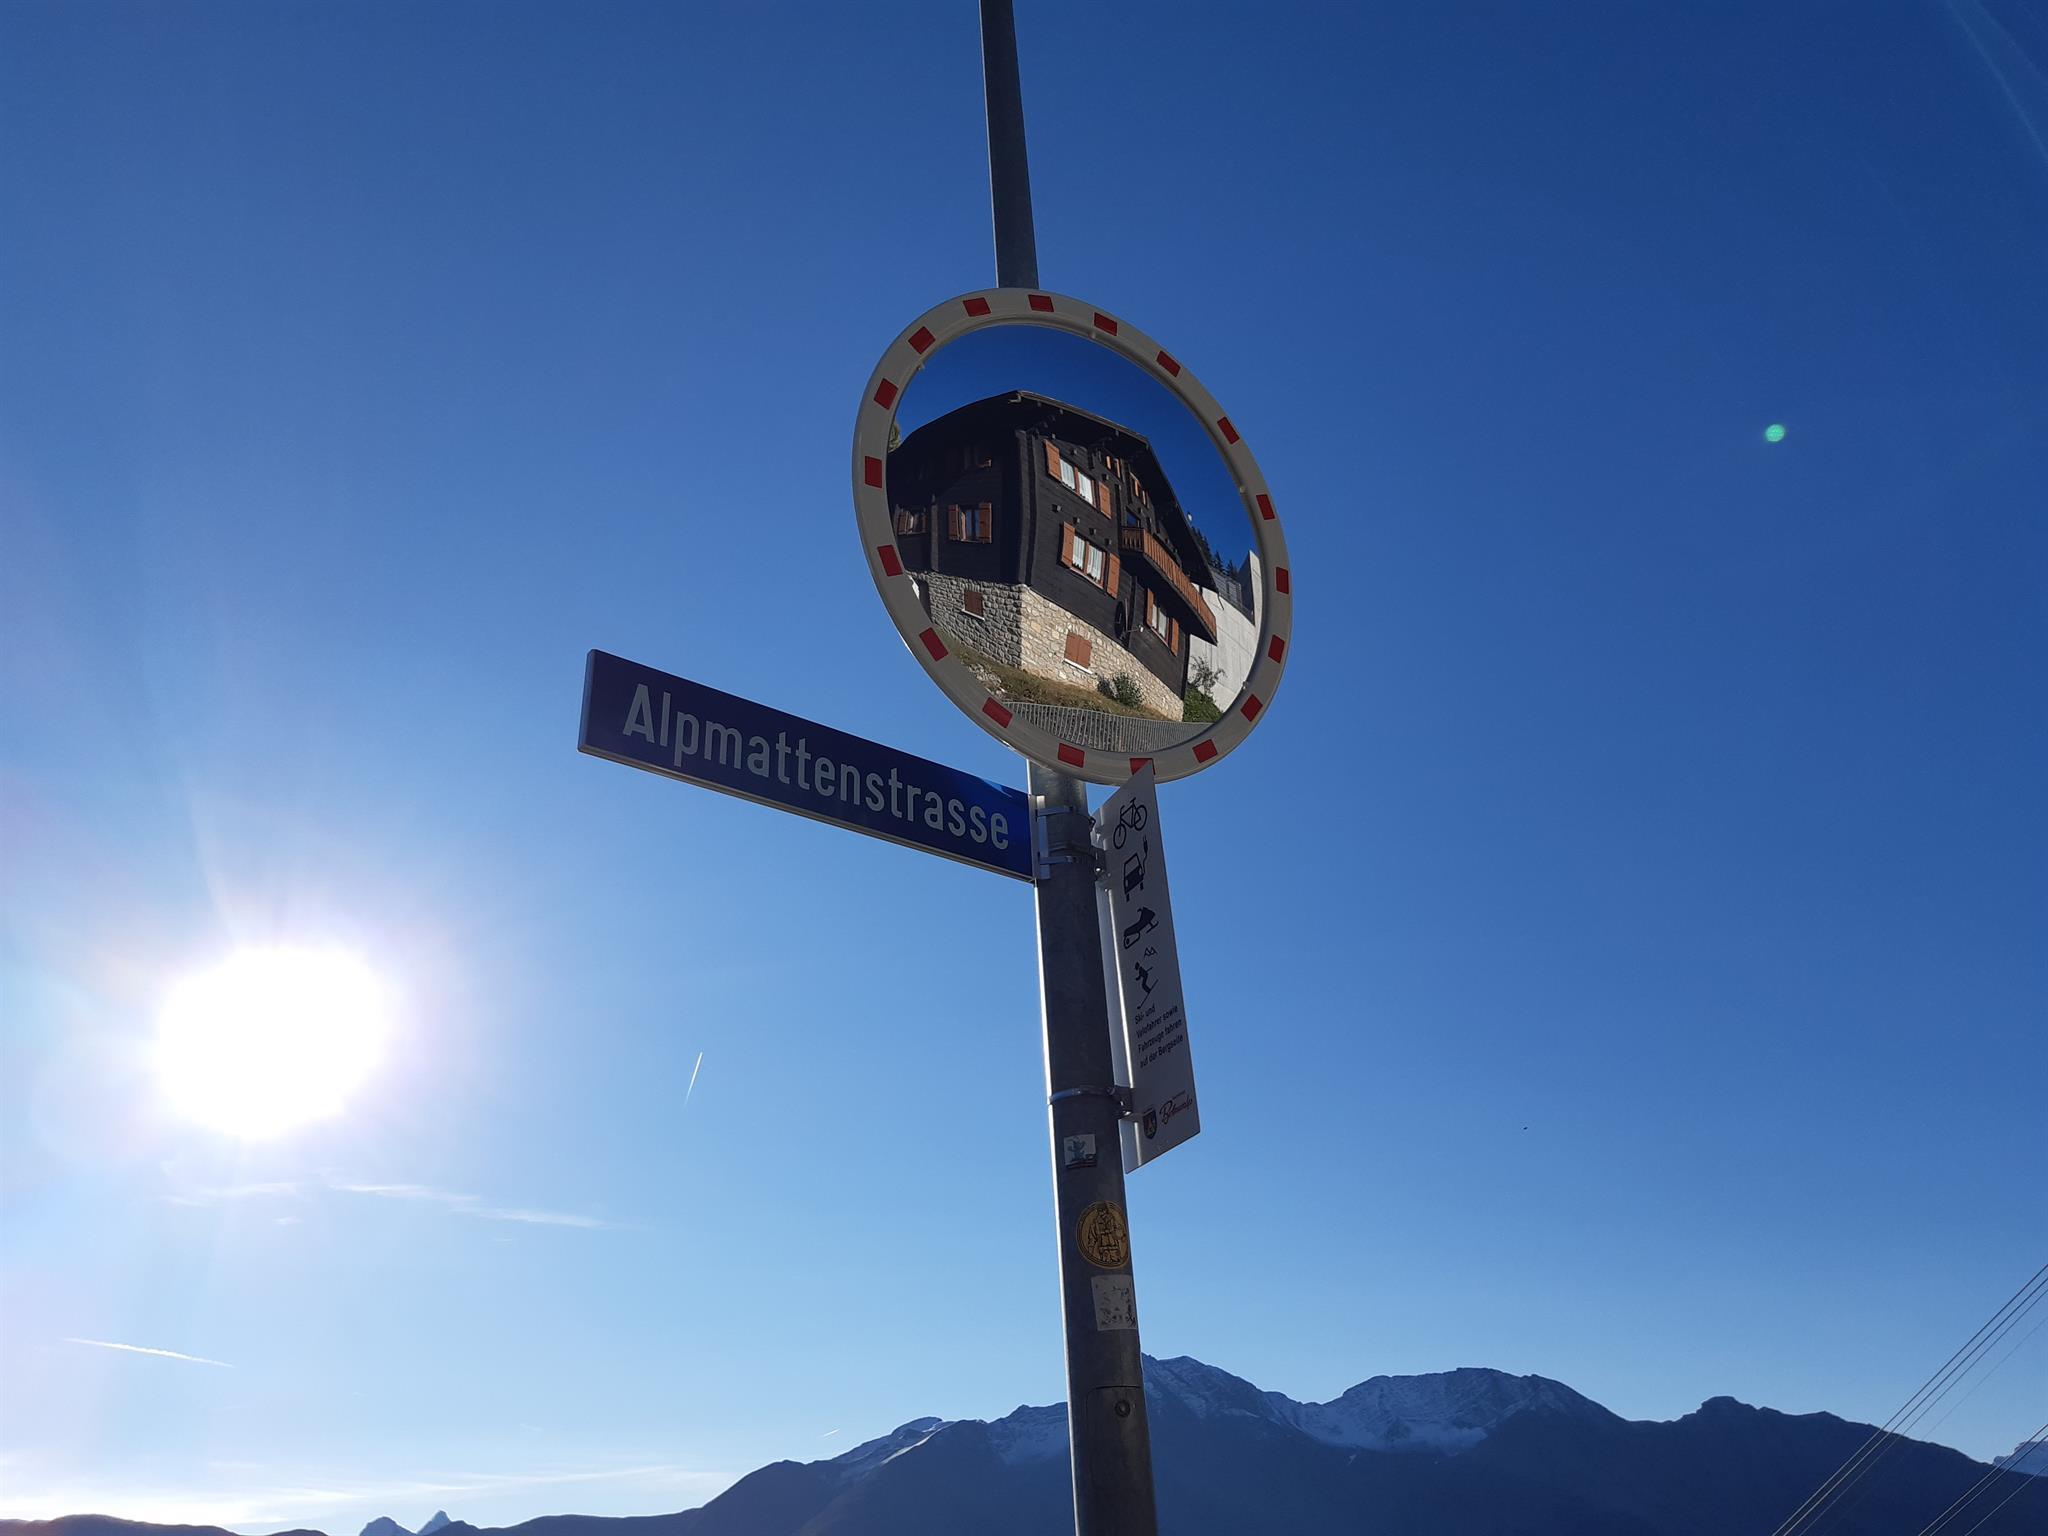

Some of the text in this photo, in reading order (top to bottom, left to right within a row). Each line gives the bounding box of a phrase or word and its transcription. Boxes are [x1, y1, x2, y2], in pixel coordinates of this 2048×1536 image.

[623, 684, 1010, 850] Alpmattenstrasse
[1162, 1005, 1178, 1020] sowie
[1138, 1019, 1182, 1053] Fahrzeuge fahren
[1158, 1034, 1183, 1055] Bergseite
